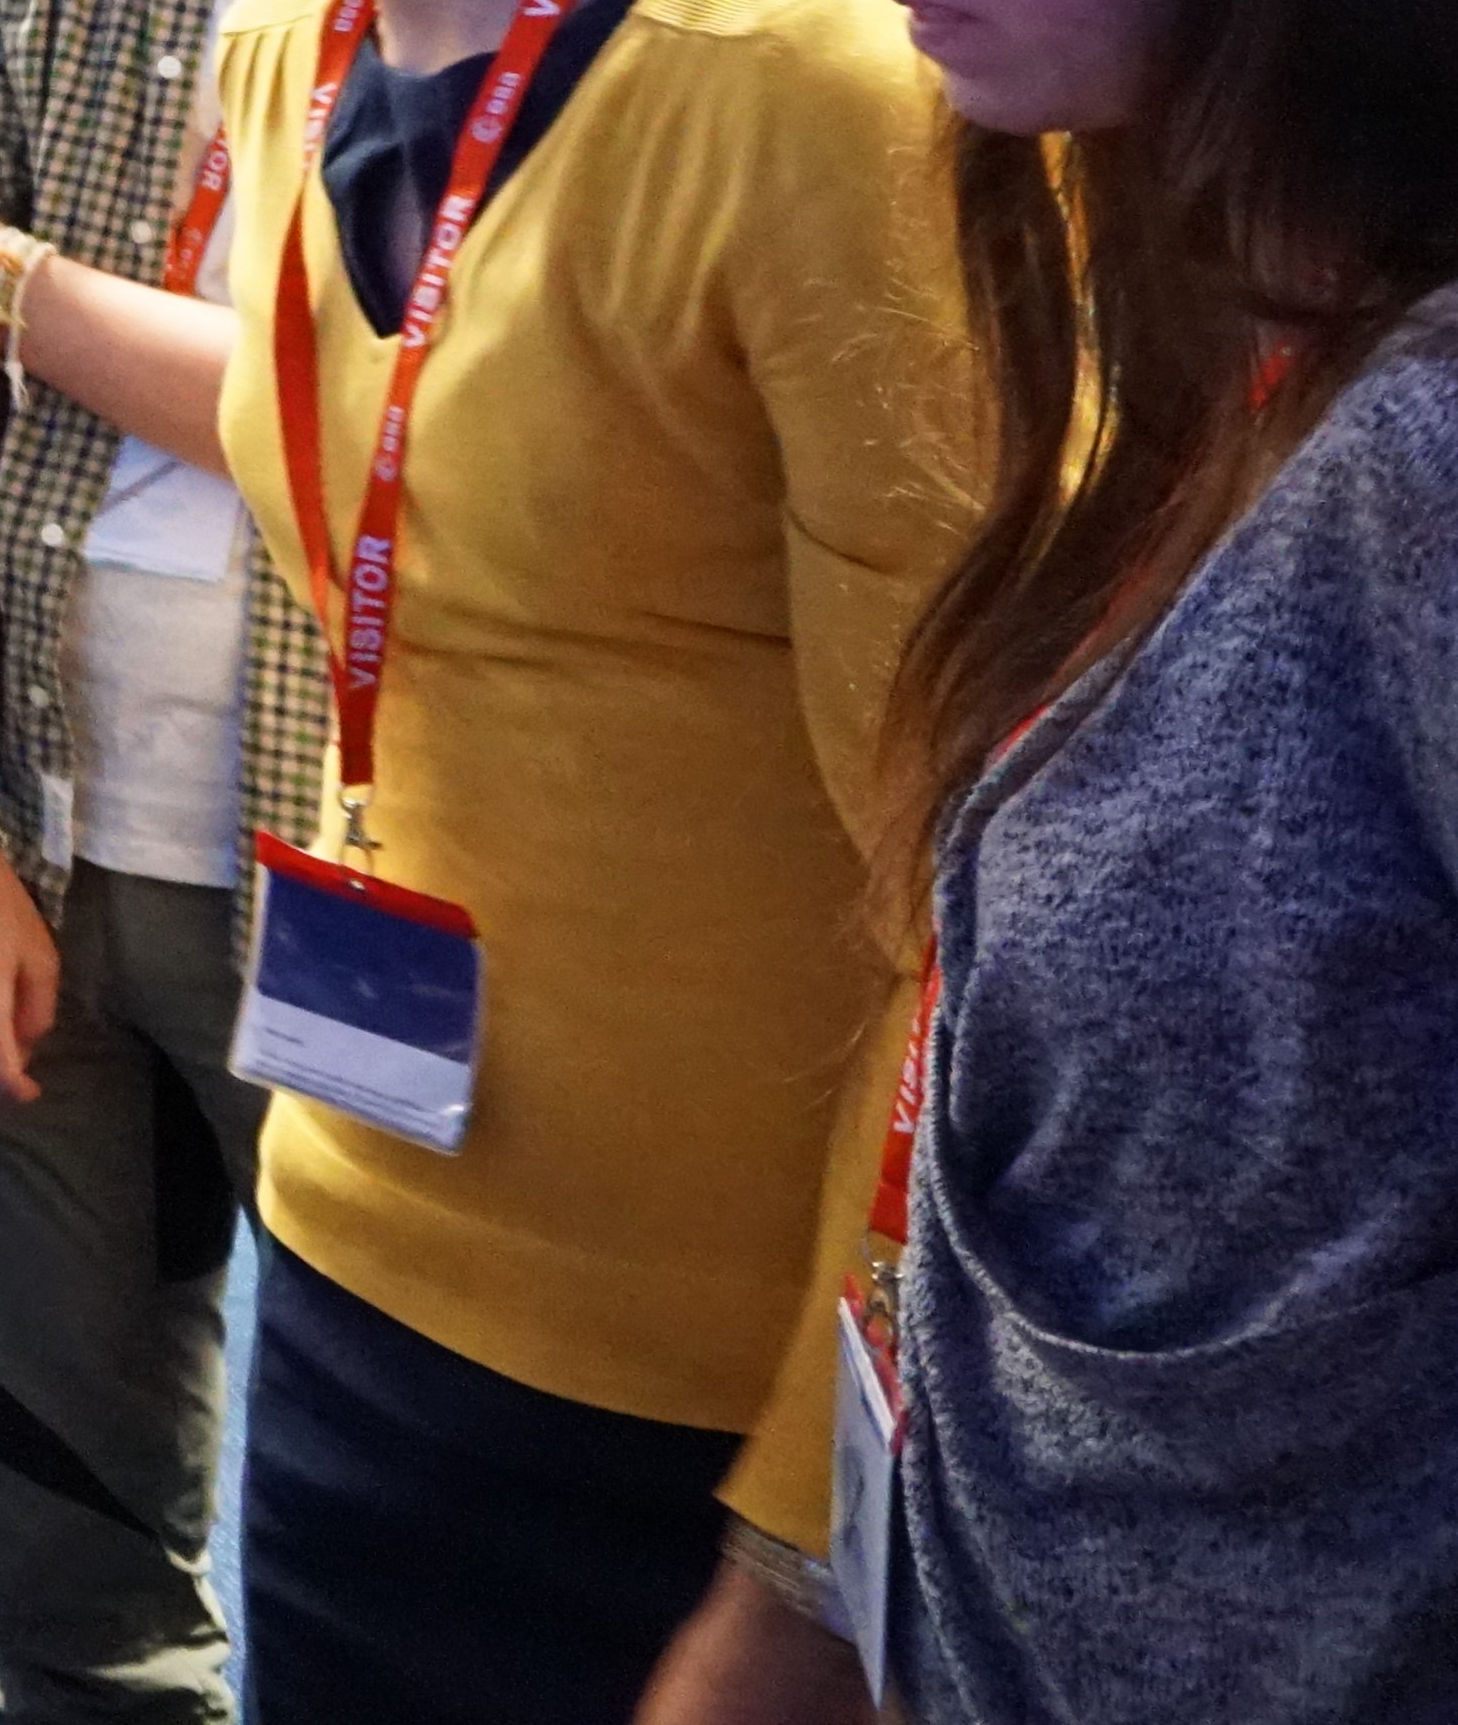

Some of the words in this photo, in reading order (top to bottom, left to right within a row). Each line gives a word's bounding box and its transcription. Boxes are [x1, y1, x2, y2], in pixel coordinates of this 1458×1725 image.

[201, 139, 228, 192] OR
[401, 193, 475, 349] VISITOR
[350, 534, 393, 690] VISITOR
